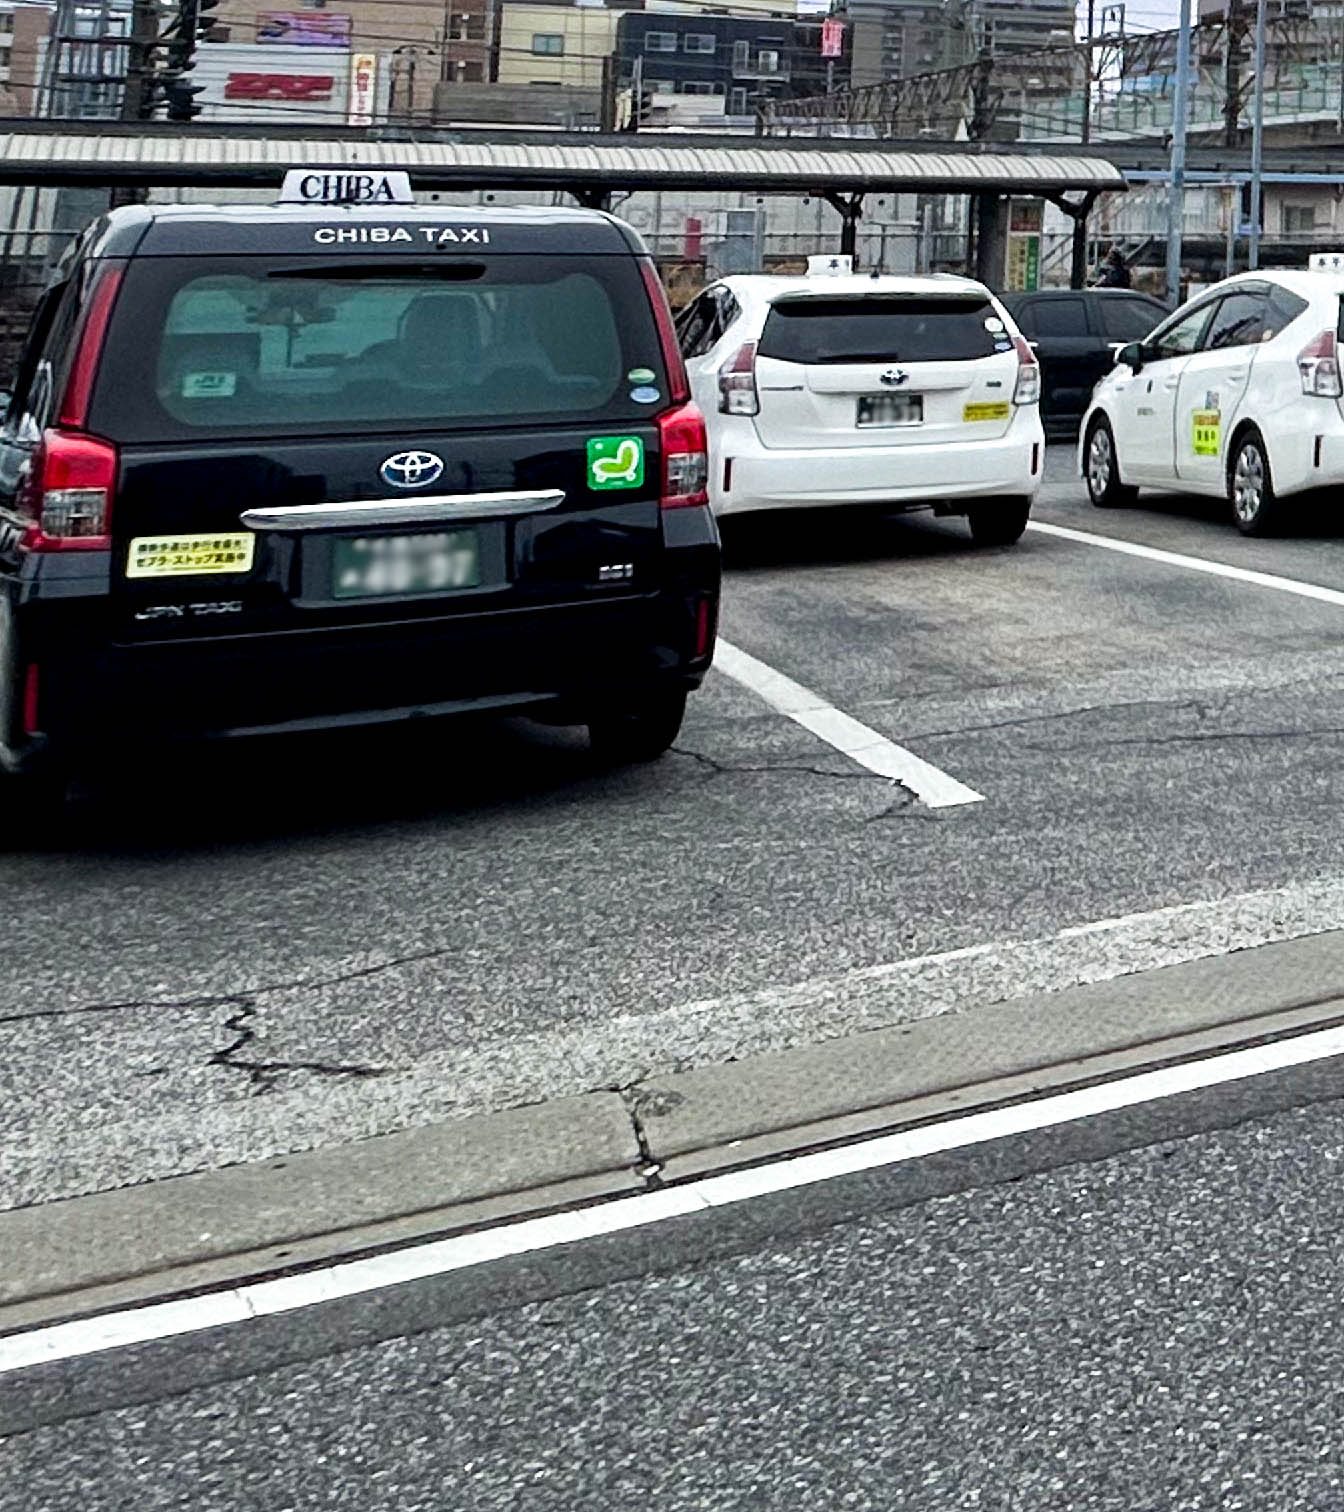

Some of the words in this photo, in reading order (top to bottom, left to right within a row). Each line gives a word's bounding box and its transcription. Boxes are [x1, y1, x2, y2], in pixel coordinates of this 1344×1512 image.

[300, 174, 394, 200] CHIBA
[314, 228, 413, 243] CHIBA
[419, 228, 490, 244] TAXI
